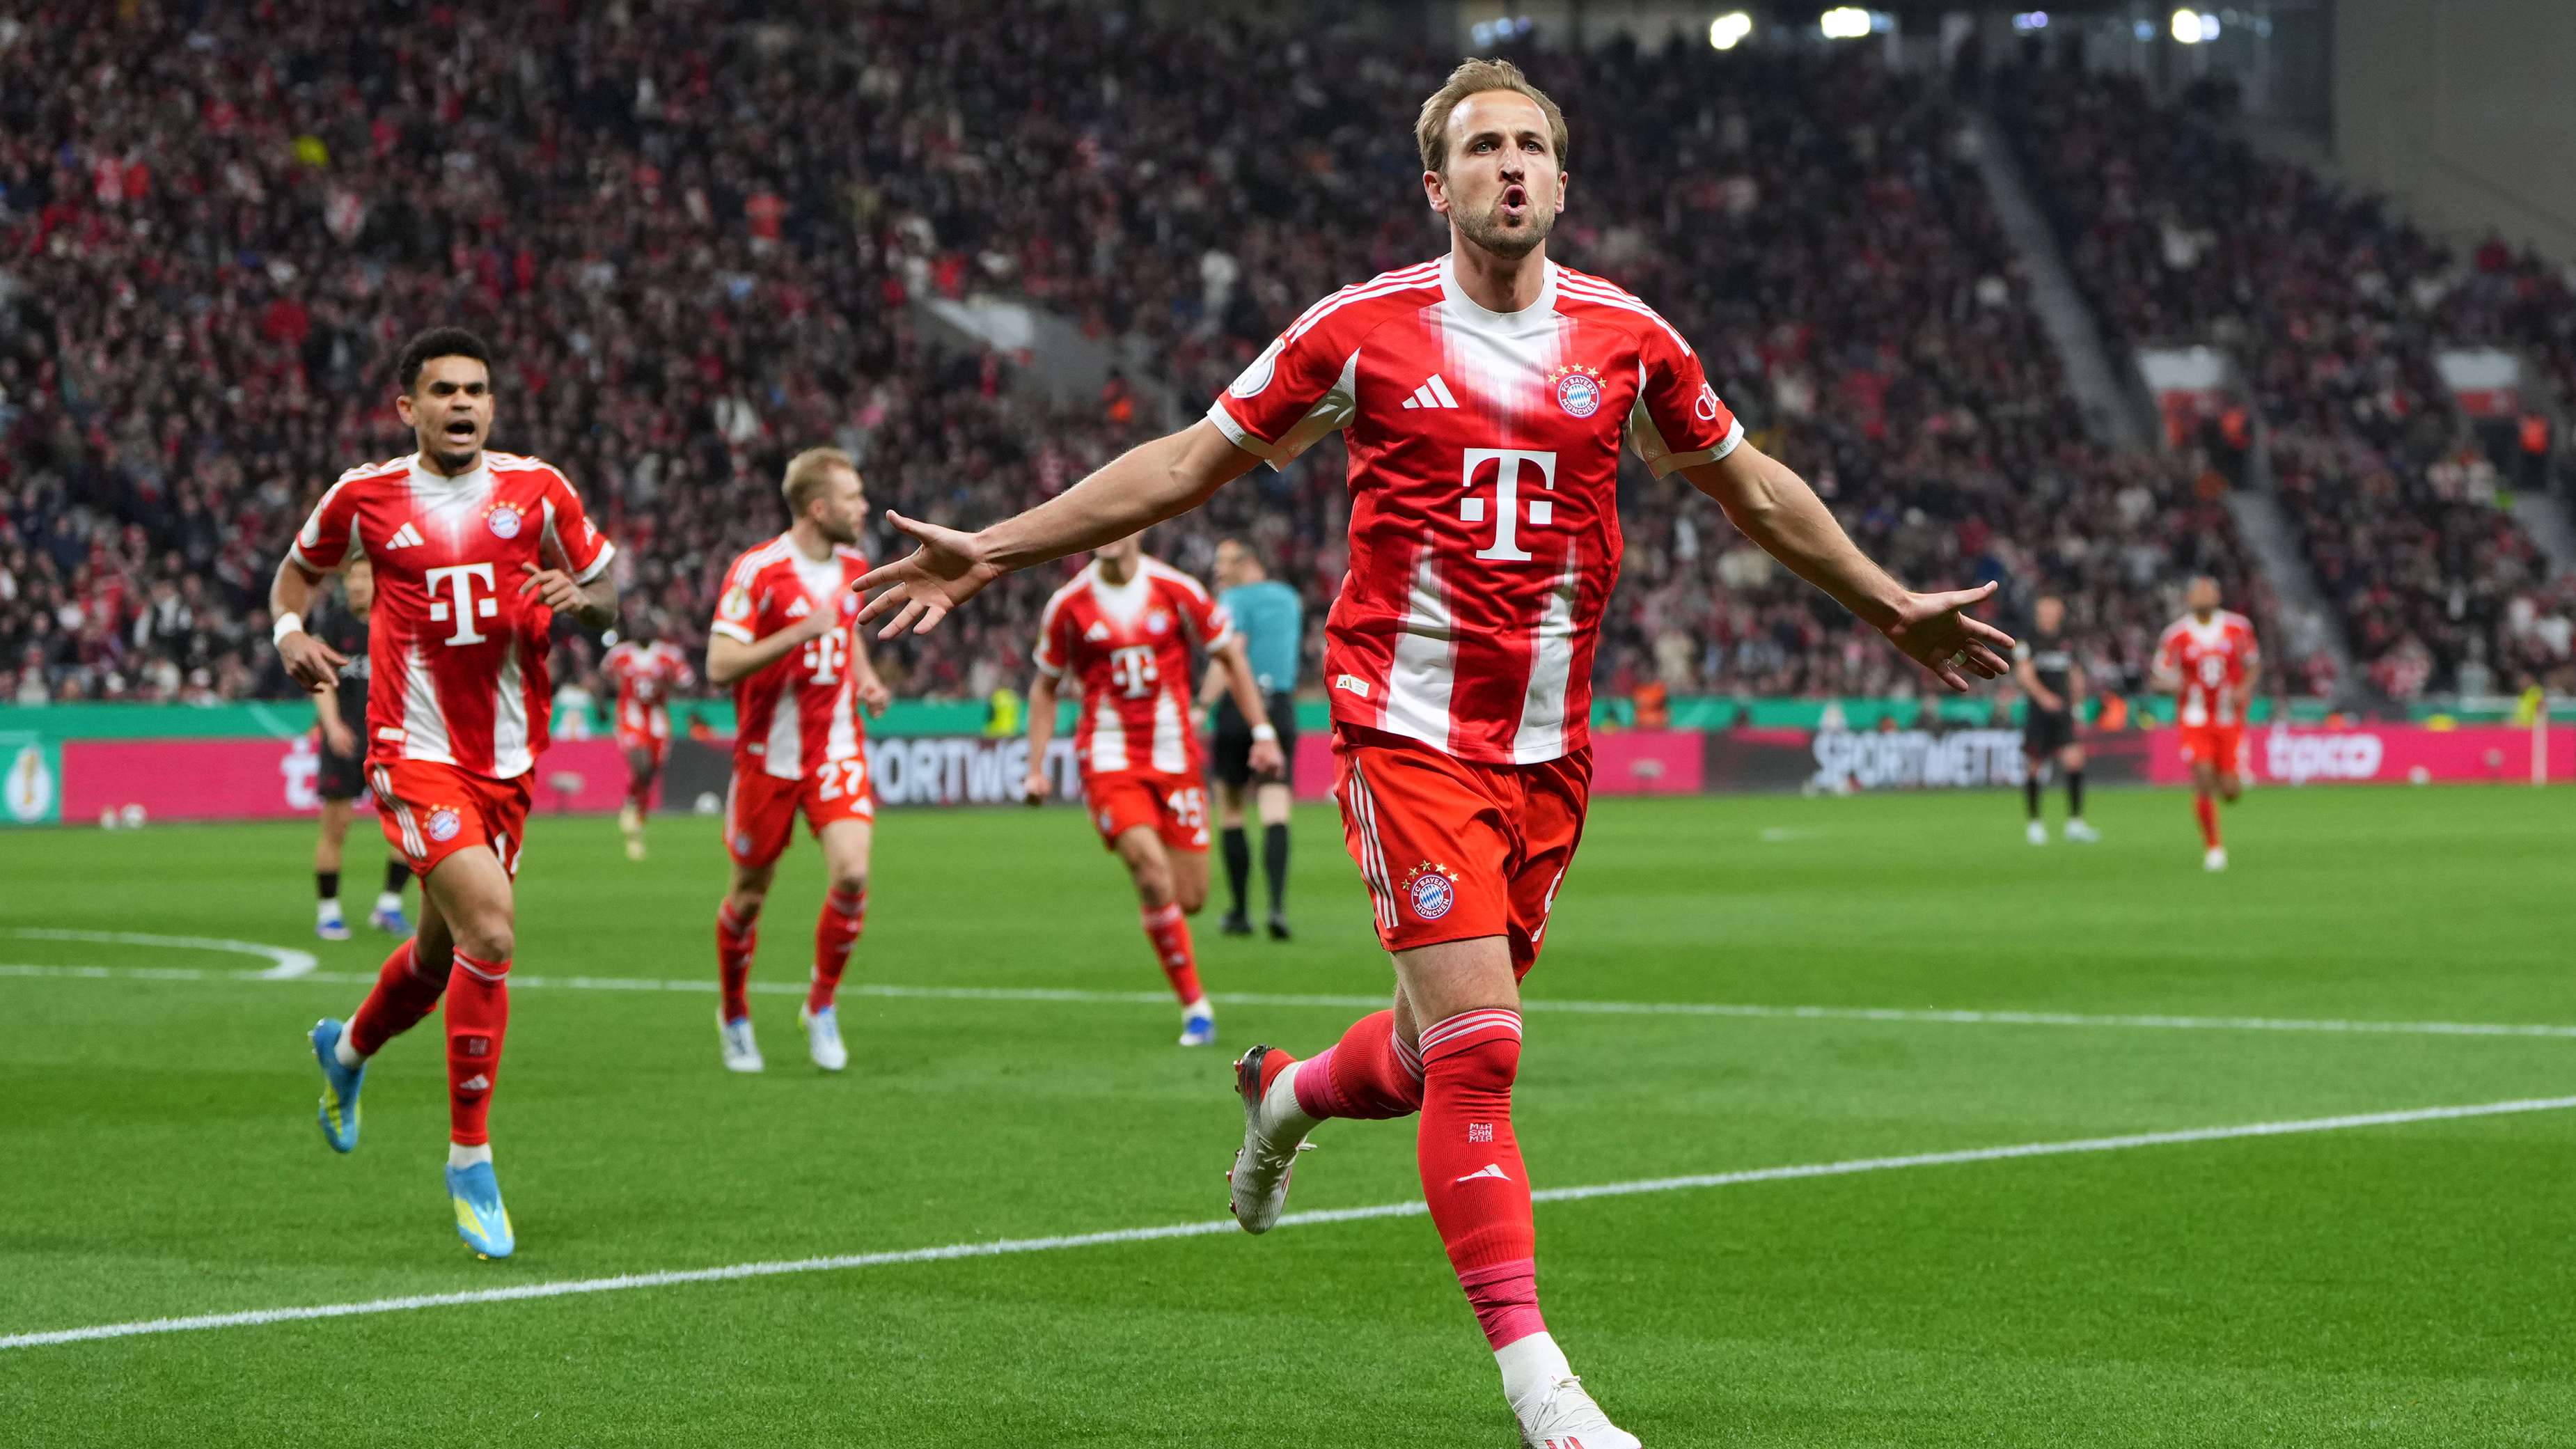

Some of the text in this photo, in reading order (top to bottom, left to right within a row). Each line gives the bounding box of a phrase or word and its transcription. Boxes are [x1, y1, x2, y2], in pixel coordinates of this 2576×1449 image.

[1561, 377, 1596, 395] FC BAYERN
[1460, 448, 1557, 561] T
[425, 562, 497, 647] T
[1110, 645, 1158, 698] T
[817, 760, 864, 801] 27
[1413, 877, 1448, 897] FC BAYERN
